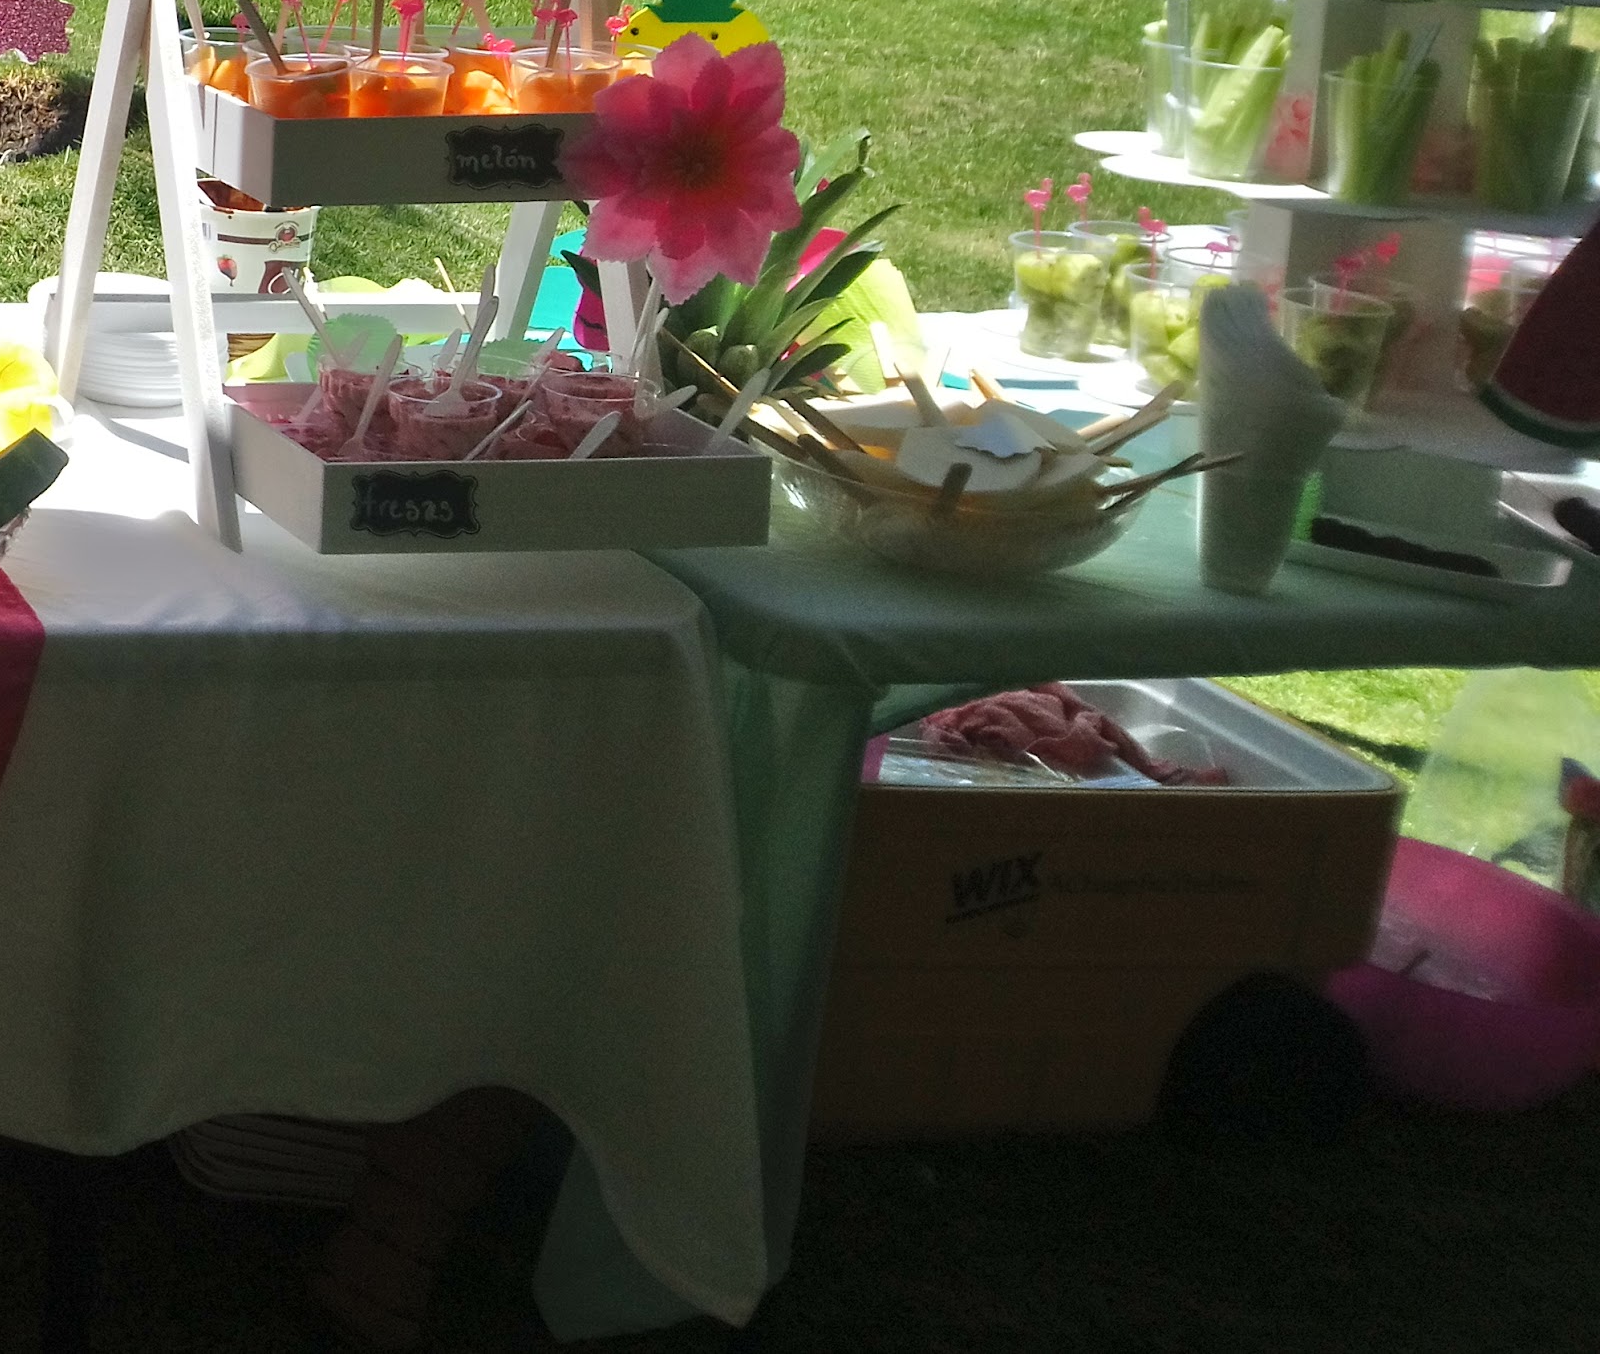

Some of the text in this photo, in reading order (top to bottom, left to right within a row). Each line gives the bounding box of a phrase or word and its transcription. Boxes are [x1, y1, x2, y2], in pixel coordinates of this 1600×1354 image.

[455, 143, 538, 175] melón
[361, 480, 456, 524] fresas
[950, 850, 1043, 908] WIX
